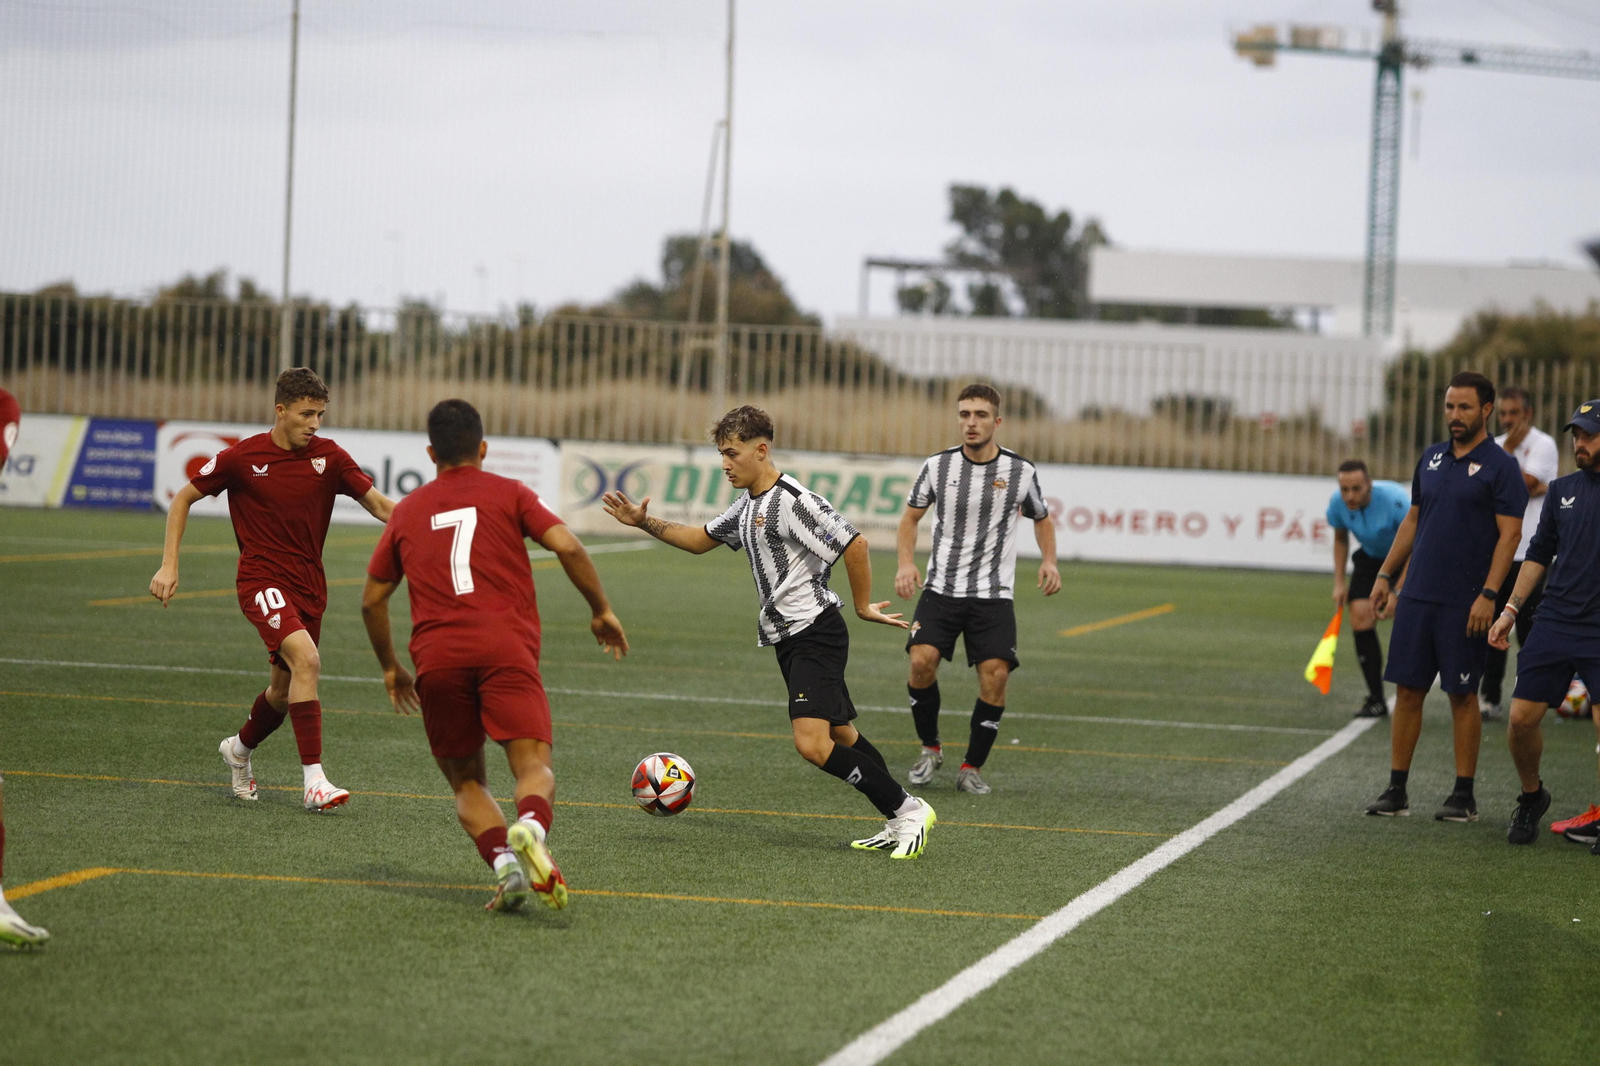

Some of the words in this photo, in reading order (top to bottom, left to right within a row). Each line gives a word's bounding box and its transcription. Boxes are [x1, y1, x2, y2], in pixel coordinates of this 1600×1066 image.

[1044, 496, 1208, 539] ROMERO
[1256, 506, 1331, 545] PÁE
[431, 506, 478, 595] 7
[254, 587, 286, 617] 10
